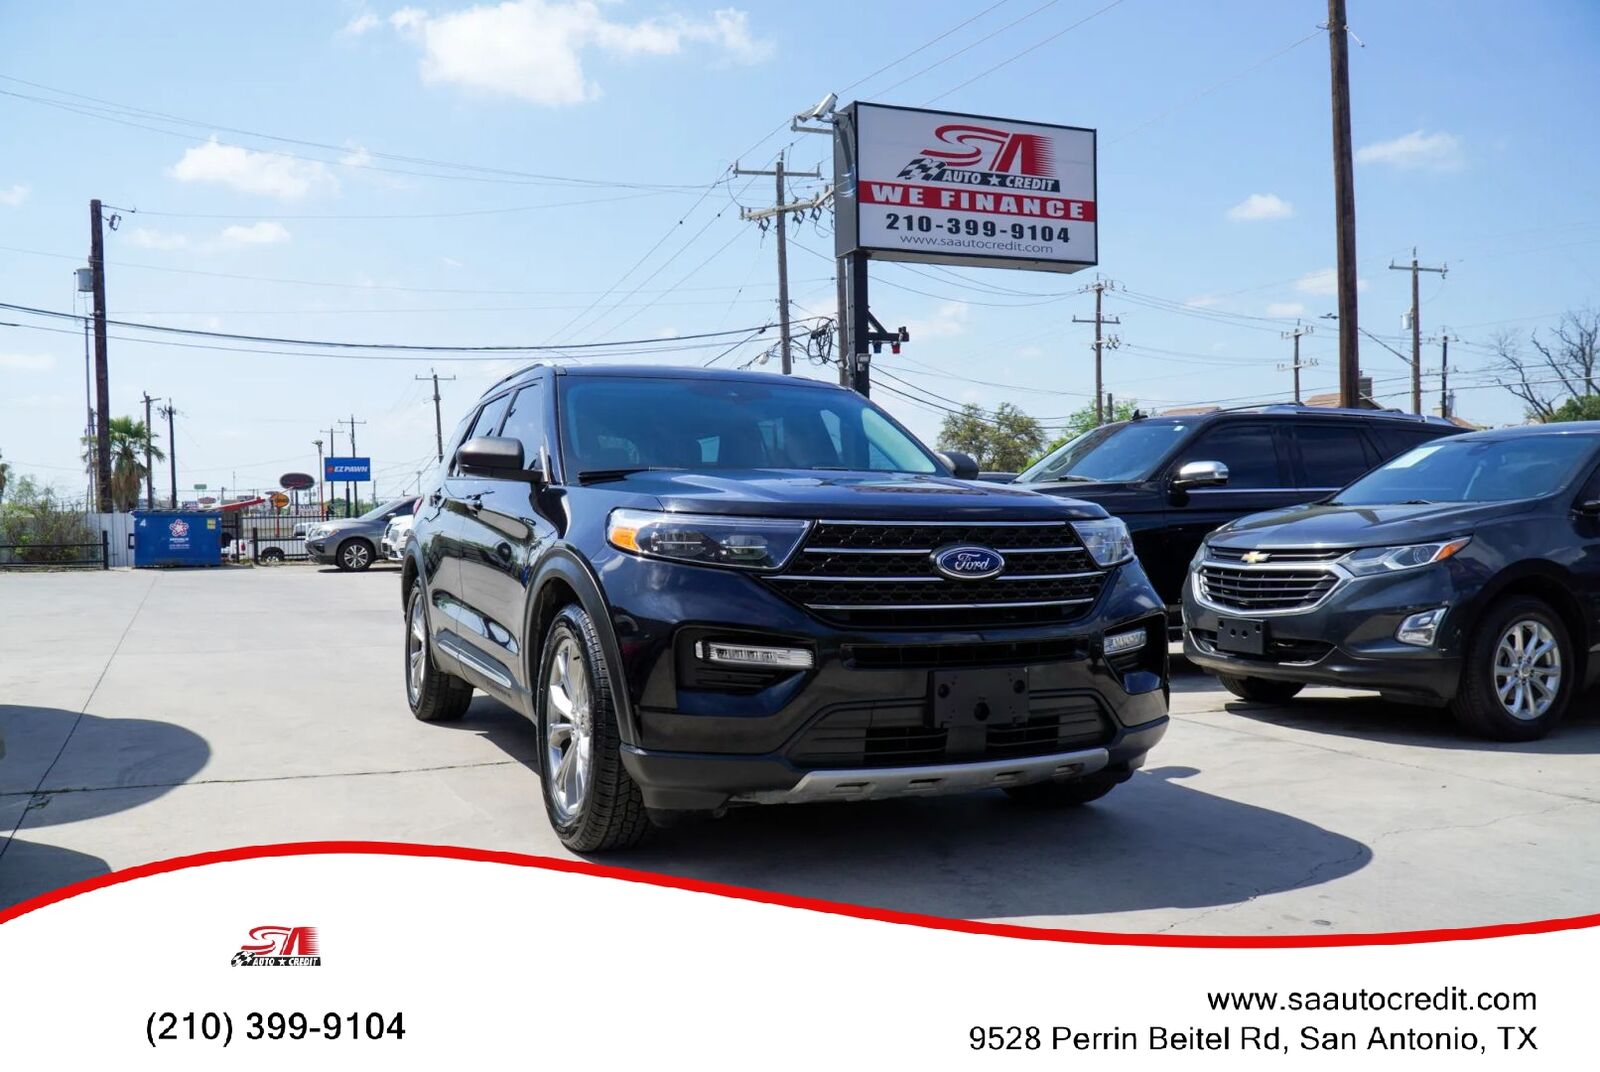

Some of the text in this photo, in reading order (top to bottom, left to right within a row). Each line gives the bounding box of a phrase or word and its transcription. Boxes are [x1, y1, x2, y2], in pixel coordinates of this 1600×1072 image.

[942, 169, 1056, 192] AUTO CREDIT
[871, 184, 1084, 219] WE FINANCE
[885, 213, 1070, 243] 210-399-9104
[900, 235, 1054, 254] www.saautocredit.com
[954, 552, 990, 571] Ford
